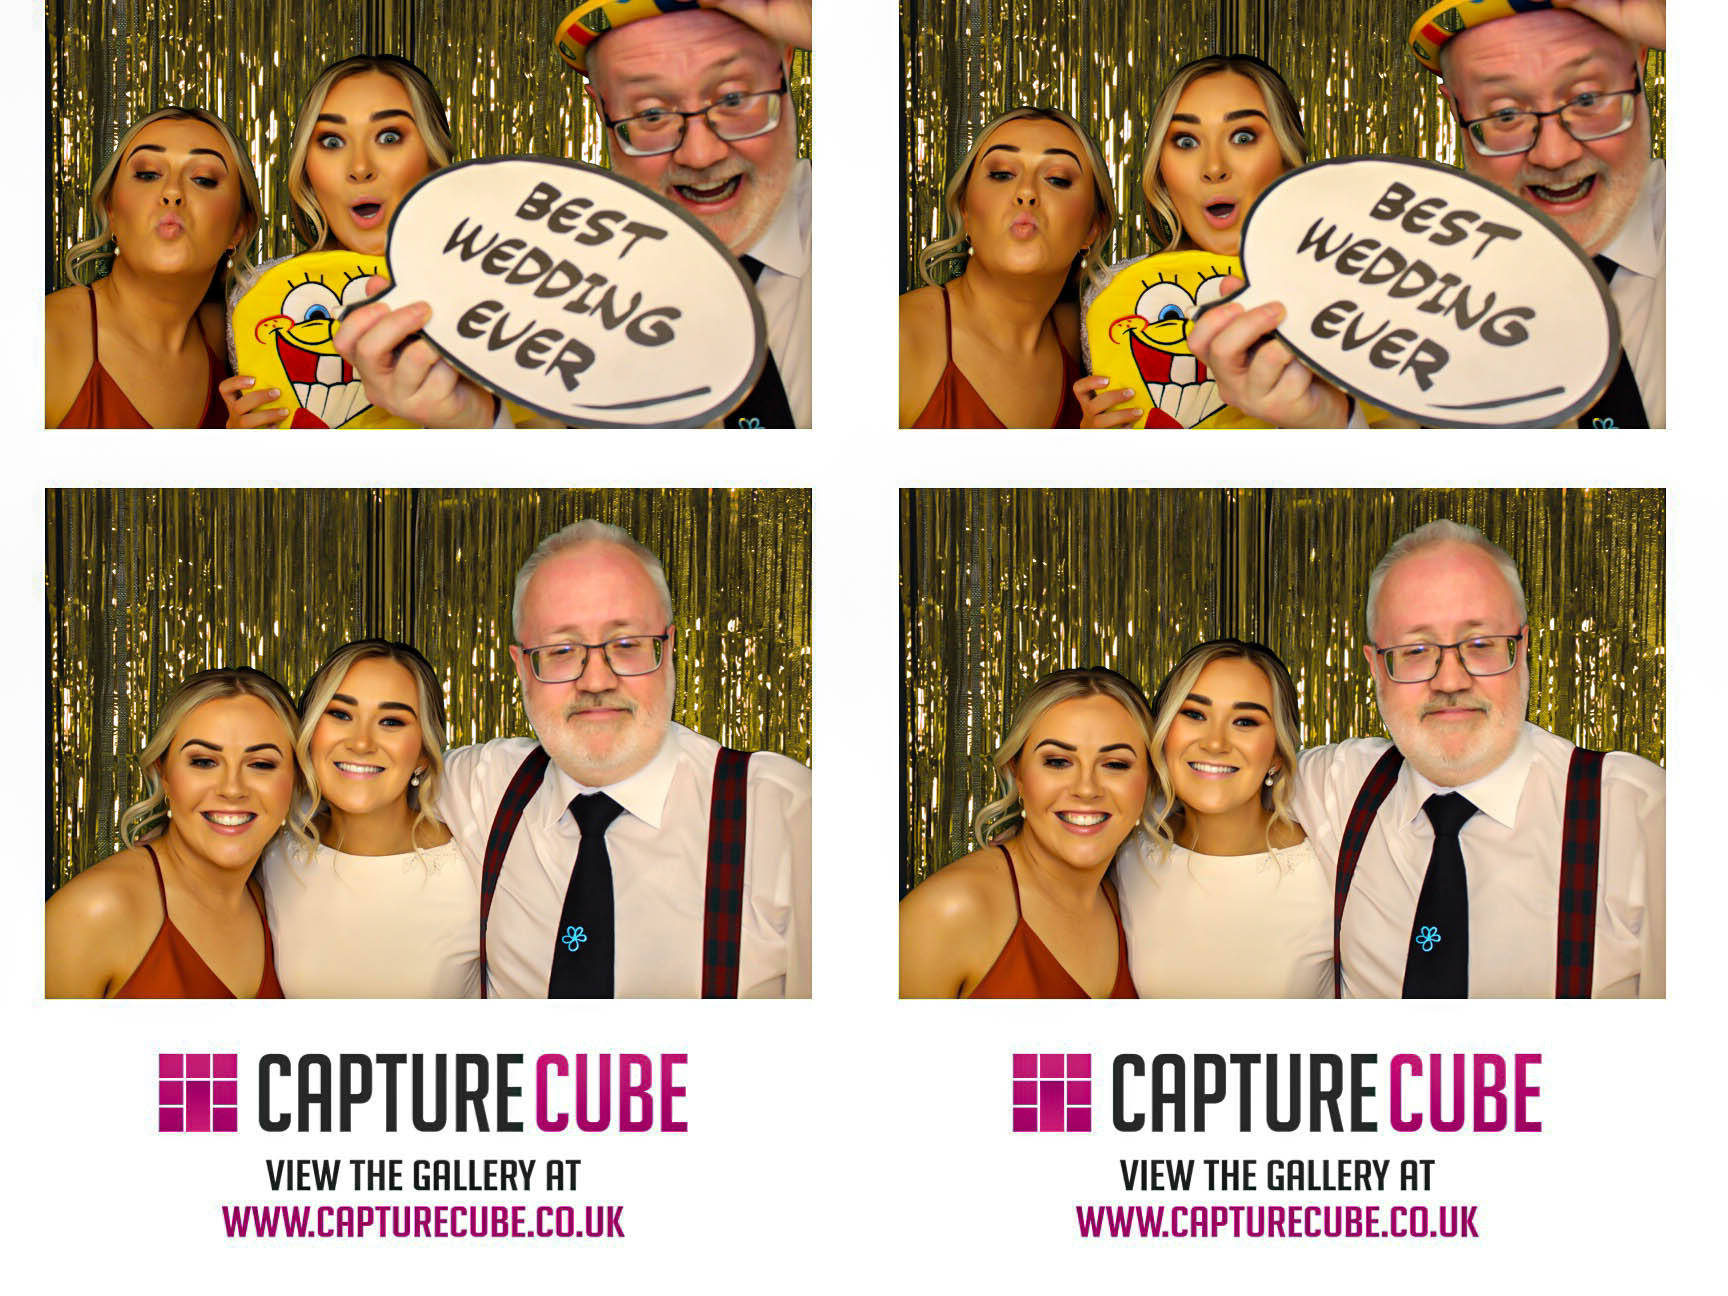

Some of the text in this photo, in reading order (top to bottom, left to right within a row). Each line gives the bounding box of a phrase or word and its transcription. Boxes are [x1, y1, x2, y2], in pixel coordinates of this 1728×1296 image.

[515, 181, 668, 259] BEST
[1369, 181, 1522, 259] BEST
[443, 217, 682, 347] WEDDING
[1297, 217, 1536, 347] WEDDING
[456, 300, 596, 392] EVER
[1310, 300, 1450, 392] EVER
